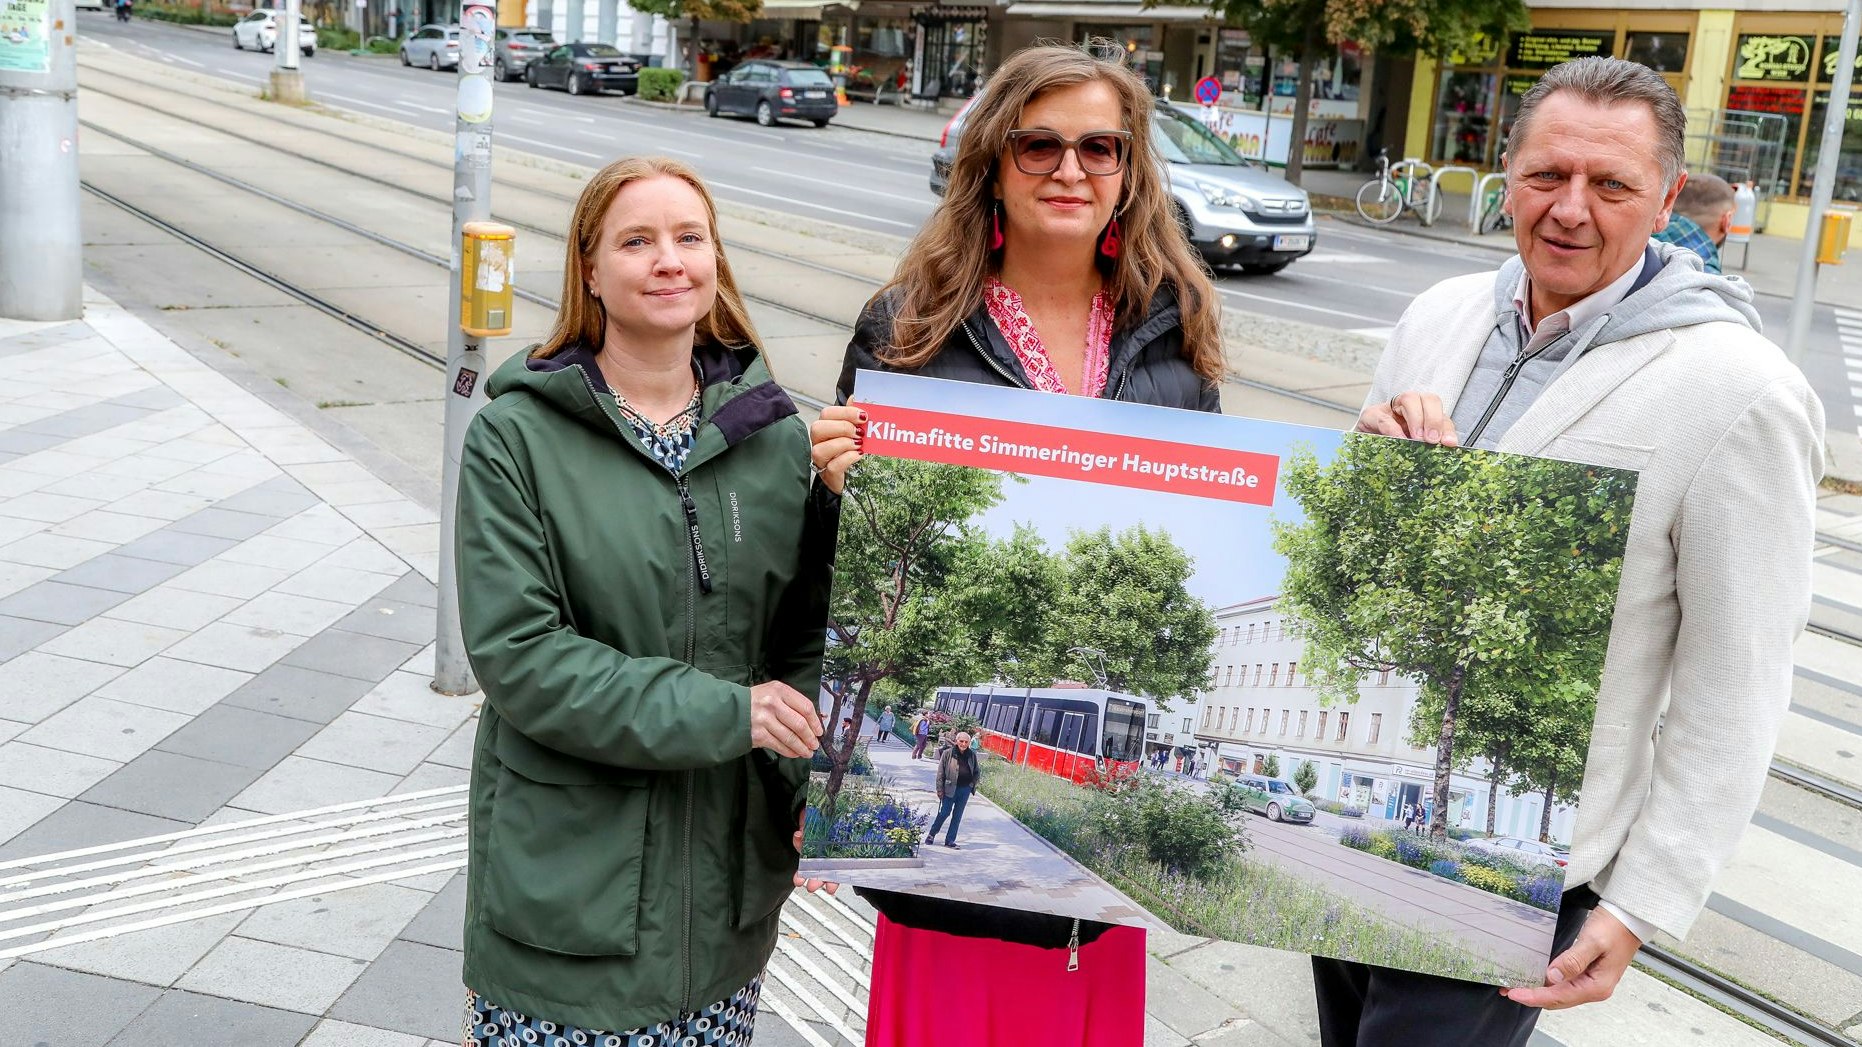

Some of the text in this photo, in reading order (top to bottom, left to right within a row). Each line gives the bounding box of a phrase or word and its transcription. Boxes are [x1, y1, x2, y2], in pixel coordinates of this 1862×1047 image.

[866, 420, 1259, 489] Klimafitte Simmeringer Hauptstraße
[729, 491, 742, 543] DIDRIKSONS
[691, 524, 710, 580] DIDRIKSONS
